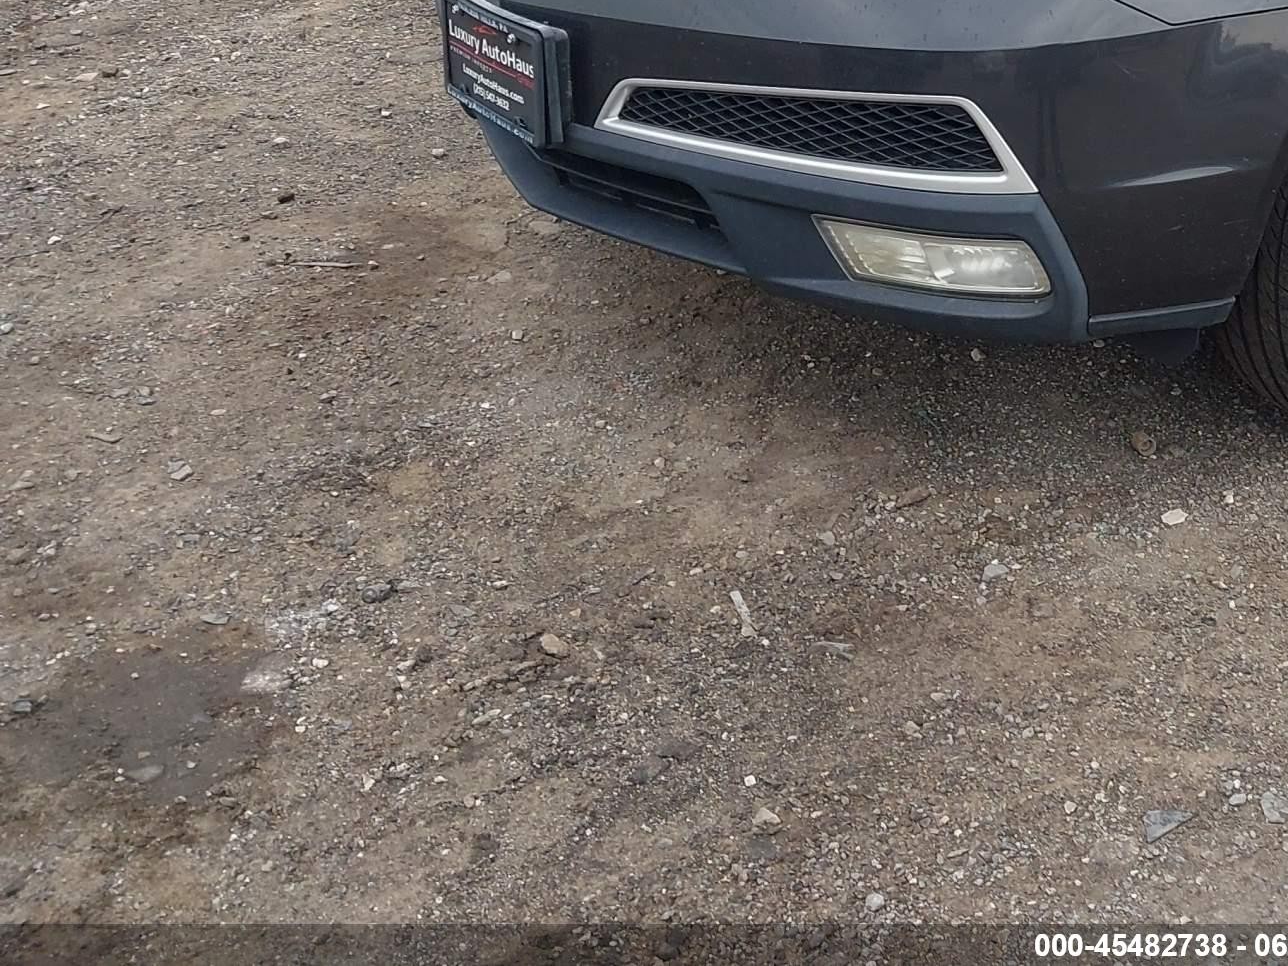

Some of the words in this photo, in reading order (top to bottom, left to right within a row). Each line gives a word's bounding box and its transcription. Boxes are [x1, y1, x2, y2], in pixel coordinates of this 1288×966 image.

[448, 18, 480, 54] Luxury
[481, 37, 534, 79] AutoHaus
[462, 62, 525, 104] LuxuryAutoHaus.com
